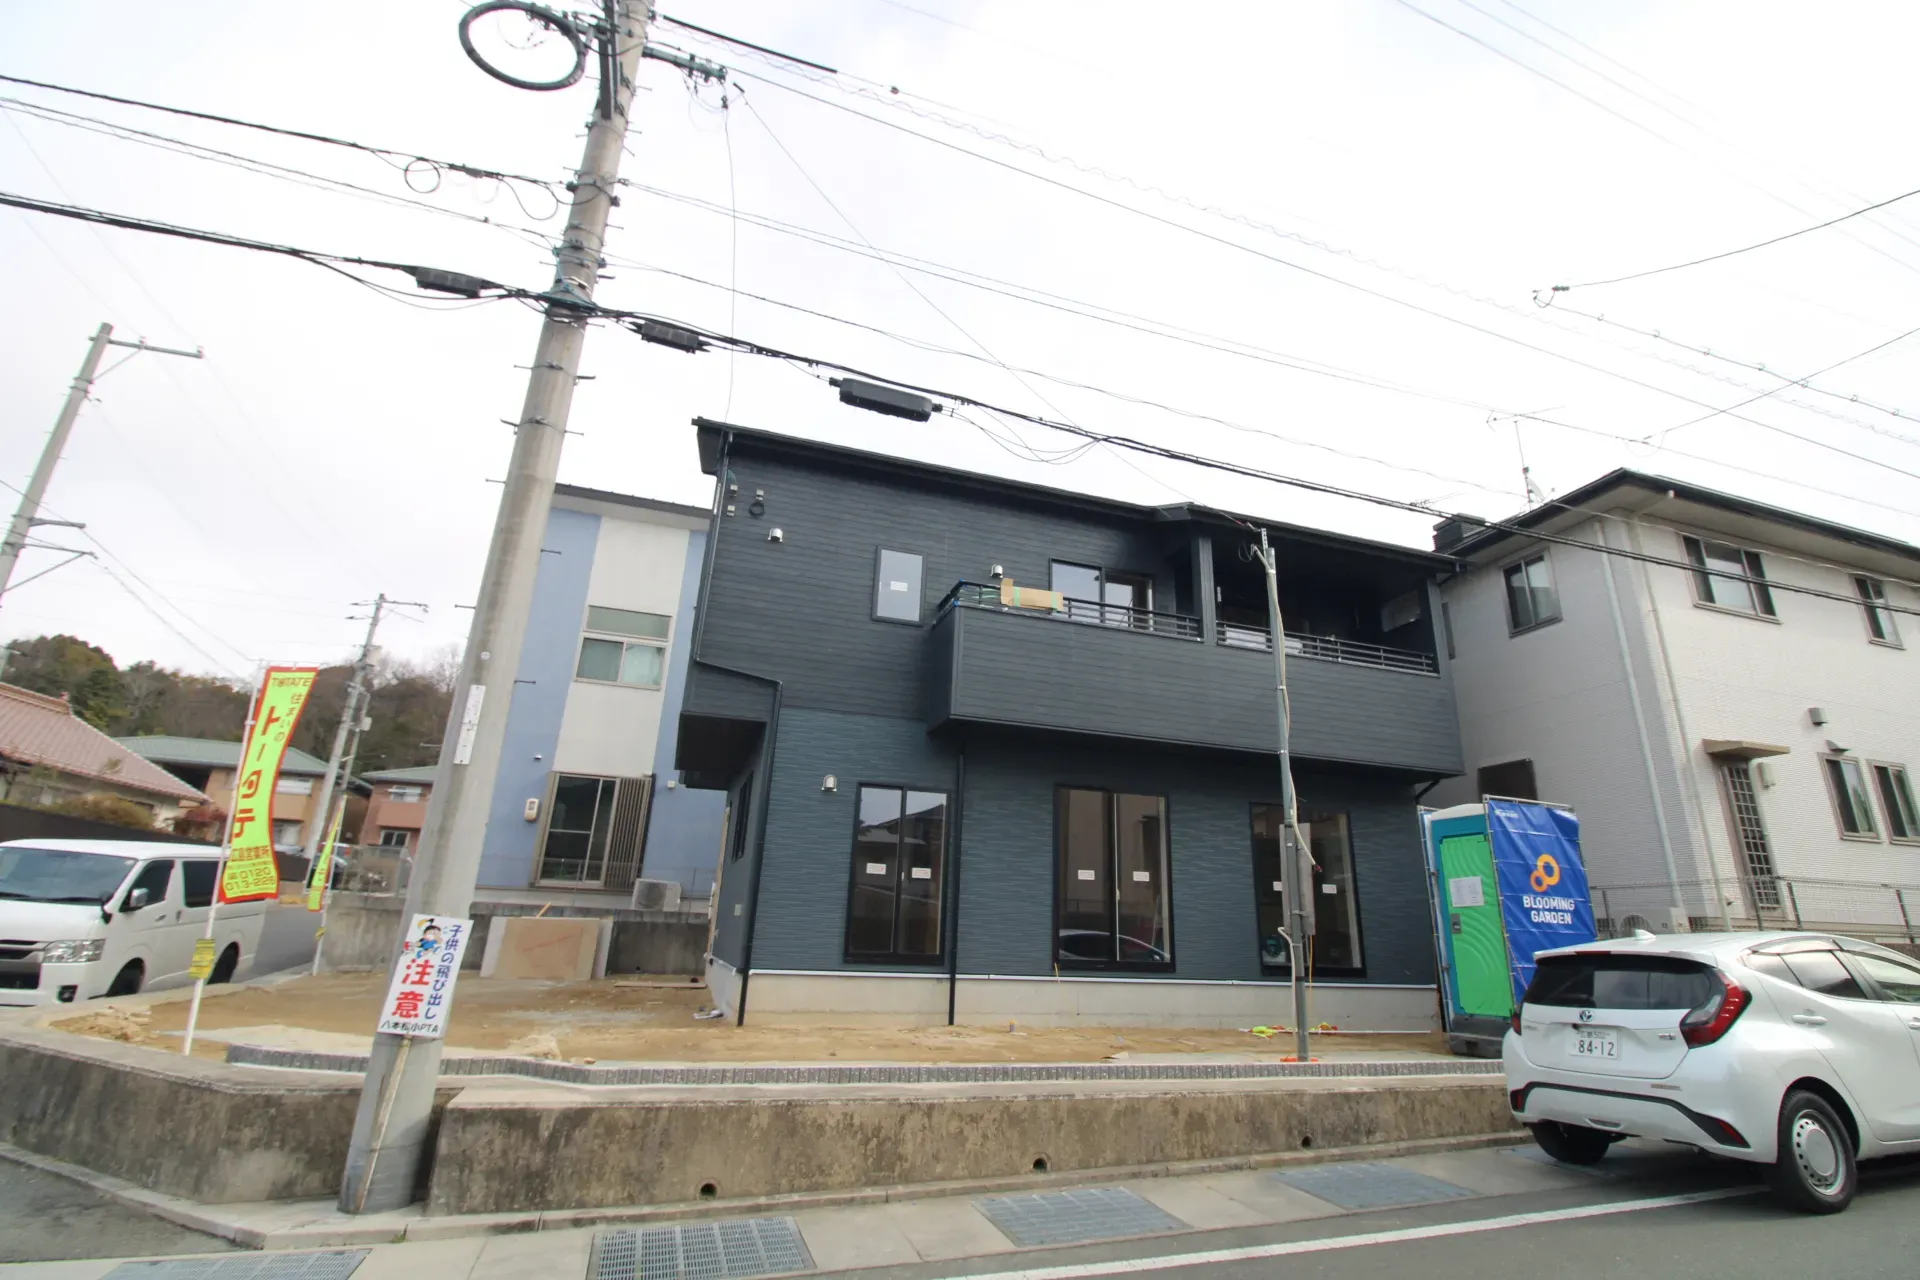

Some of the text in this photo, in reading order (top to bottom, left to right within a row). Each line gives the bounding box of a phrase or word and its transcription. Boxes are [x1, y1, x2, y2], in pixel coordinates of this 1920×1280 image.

[232, 705, 281, 838] トータテ
[240, 867, 271, 880] 0120
[1523, 895, 1575, 911] BLOOMING
[1530, 910, 1572, 925] GARDEN
[424, 924, 463, 1020] 子供の飛び出し
[391, 958, 435, 1019] 注意
[1578, 1039, 1615, 1057] 84-12
